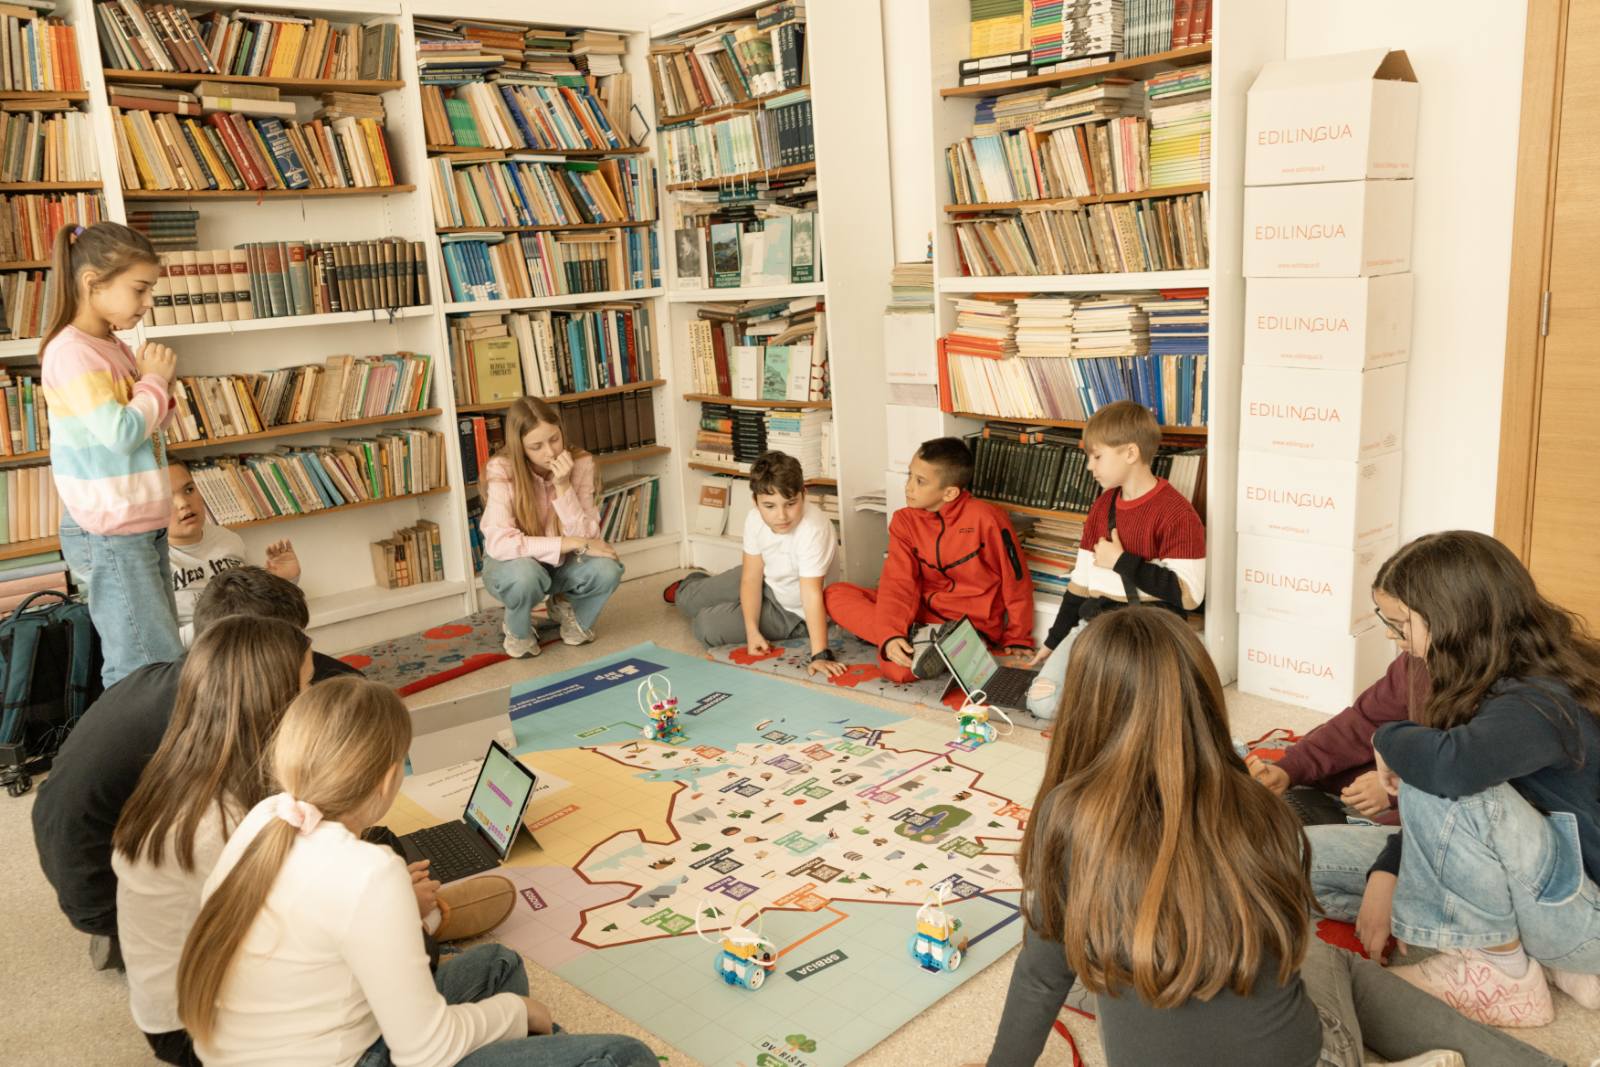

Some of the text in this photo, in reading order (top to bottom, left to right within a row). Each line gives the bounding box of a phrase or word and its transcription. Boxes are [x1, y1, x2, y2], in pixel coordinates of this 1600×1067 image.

[1258, 124, 1352, 146] EDILINGUA
[1255, 224, 1346, 240] EDILINGUA
[1257, 315, 1350, 332] EDILINGUA
[1249, 402, 1341, 422] EDILINGUA
[1246, 486, 1335, 510] EDILINGUA
[1244, 568, 1333, 596] EDILINGUA
[1247, 649, 1335, 679] EDILINGUA
[796, 953, 840, 975] SRBIJA
